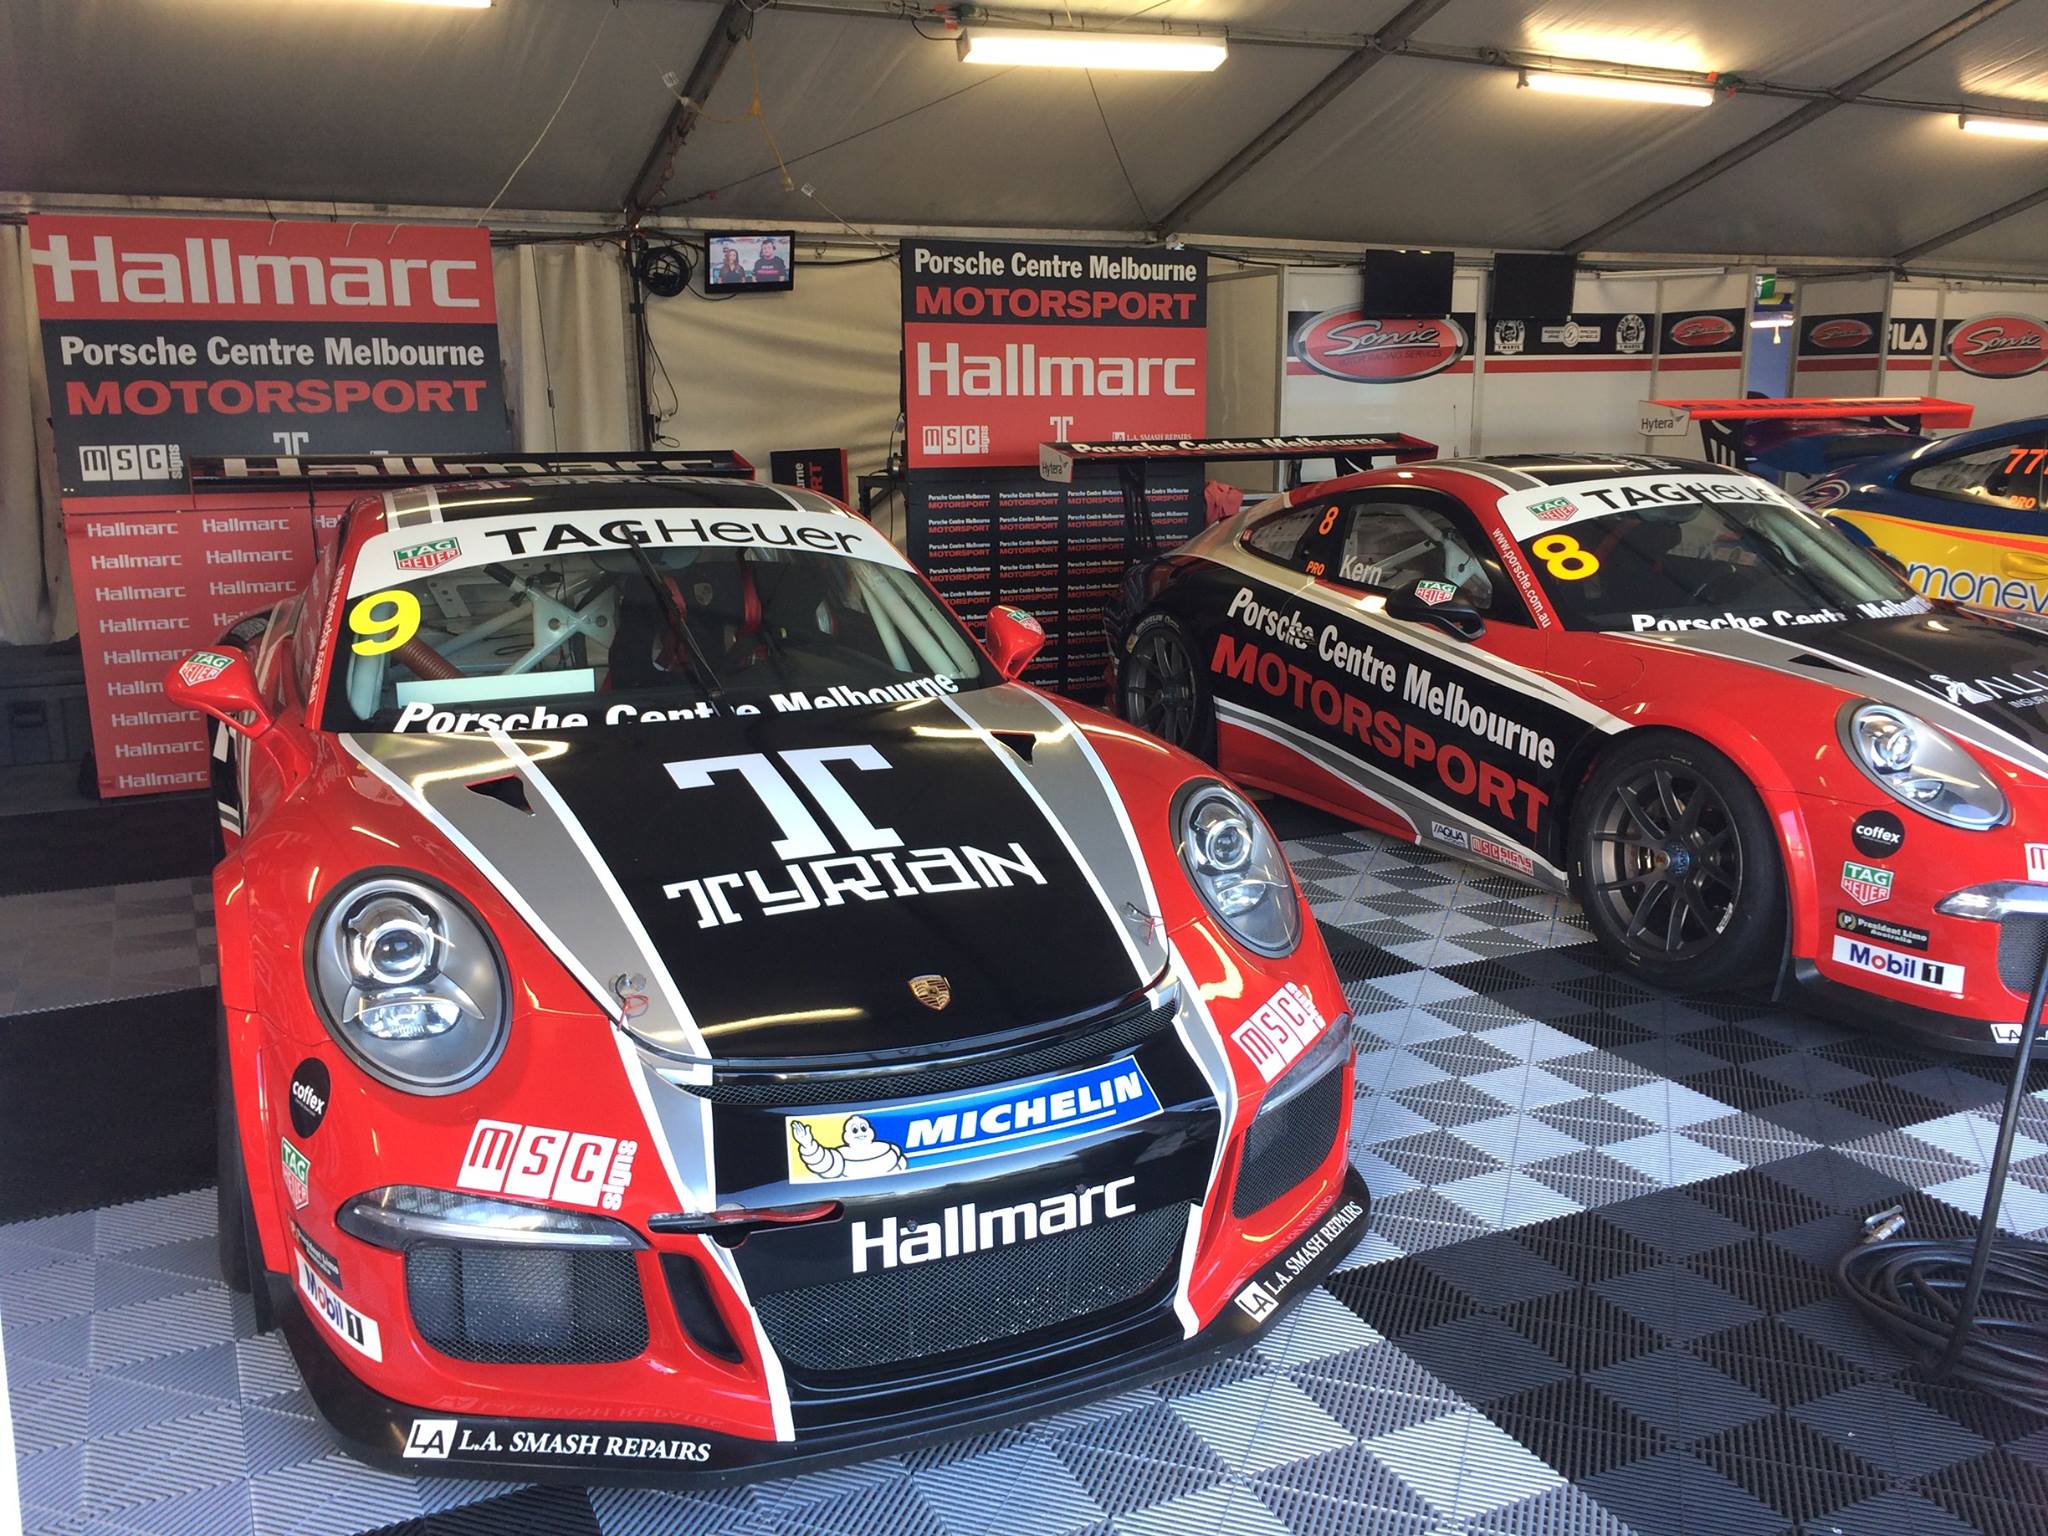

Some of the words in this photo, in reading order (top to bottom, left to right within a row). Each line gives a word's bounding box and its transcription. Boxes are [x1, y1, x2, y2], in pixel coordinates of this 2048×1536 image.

[30, 235, 480, 308] Hallmarc
[915, 248, 1005, 277] Porsche
[1011, 252, 1083, 279] Centre
[1090, 255, 1197, 282] Melbourne
[915, 286, 1197, 320] MOTORSPORT
[1326, 320, 1441, 352] Sonic
[1967, 326, 2041, 353] Sonic
[61, 336, 196, 366] Porsche
[207, 336, 315, 367] Centre
[325, 337, 485, 367] Melbourne
[917, 342, 1196, 397] Hallmarc
[66, 379, 487, 416] MOTORSPORT
[1641, 419, 1674, 432] Hytera
[222, 456, 714, 477] Hallmarc
[2004, 448, 2048, 475] 77
[928, 501, 990, 509] MOTORSPORT
[1532, 499, 1568, 512] TAG
[1538, 506, 1578, 521] HEUER
[87, 522, 178, 537] Hallmarc
[202, 518, 290, 533] Hallmarc
[928, 525, 990, 533] MOTORSPORT
[999, 522, 1058, 530] MOTORSPORT
[1067, 520, 1124, 528] MOTORSPORT
[1319, 505, 1339, 535] 8
[402, 539, 453, 557] TAG
[928, 549, 990, 557] MOTORSPORT
[999, 546, 1058, 554] MOTORSPORT
[1067, 544, 1124, 552] MOTORSPORT
[1532, 534, 1600, 580] 8
[91, 554, 182, 569] Hallmarc
[206, 549, 293, 565] Hallmarc
[399, 550, 460, 569] HEUER
[1306, 561, 1325, 576] PRO
[930, 573, 991, 582] MOTORSPORT
[999, 570, 1058, 578] MOTORSPORT
[1339, 554, 1383, 586] Kern
[1492, 527, 1551, 630] www.porsche.com.au
[95, 586, 186, 602] Hallmarc
[209, 580, 296, 596] Hallmarc
[1417, 589, 1452, 604] HEUER
[1421, 581, 1456, 593] TAG
[99, 616, 190, 633] Hallmarc
[348, 590, 421, 656] 9
[193, 653, 229, 667] TAG
[181, 664, 218, 683] HEUER
[1227, 587, 1315, 651] Porsche
[1318, 625, 1397, 692] Centre
[1403, 664, 1555, 769] Melbourne
[107, 680, 164, 696] Hallm
[111, 709, 201, 728] Hallmarc
[393, 701, 589, 734] Porsche
[606, 701, 761, 726] Cente
[1210, 634, 1549, 832] MOTORSPORT
[115, 740, 204, 758] Hallmarc
[119, 769, 208, 789] Hallmarc
[1856, 824, 1901, 844] coffex
[1501, 848, 1532, 868] SIGNS
[1848, 864, 1888, 885] TAG
[1844, 880, 1888, 905] HEUER
[1858, 918, 1902, 936] President
[1903, 929, 1927, 942] Limo
[1850, 943, 1916, 979] Mobil
[292, 1079, 325, 1115] coffex
[903, 1071, 1143, 1149] MICHELIN
[283, 1145, 307, 1182] TAG
[603, 1139, 638, 1211] signs
[852, 1176, 1137, 1274] Hallmarc
[1264, 1270, 1293, 1295] L.A.
[1285, 1237, 1327, 1278] SMASH
[1320, 1200, 1364, 1244] REPAIRS
[304, 1263, 344, 1330] Mobil
[458, 1429, 502, 1451] L.A.
[509, 1431, 599, 1456] SMASH
[604, 1437, 711, 1462] REPAIRS
